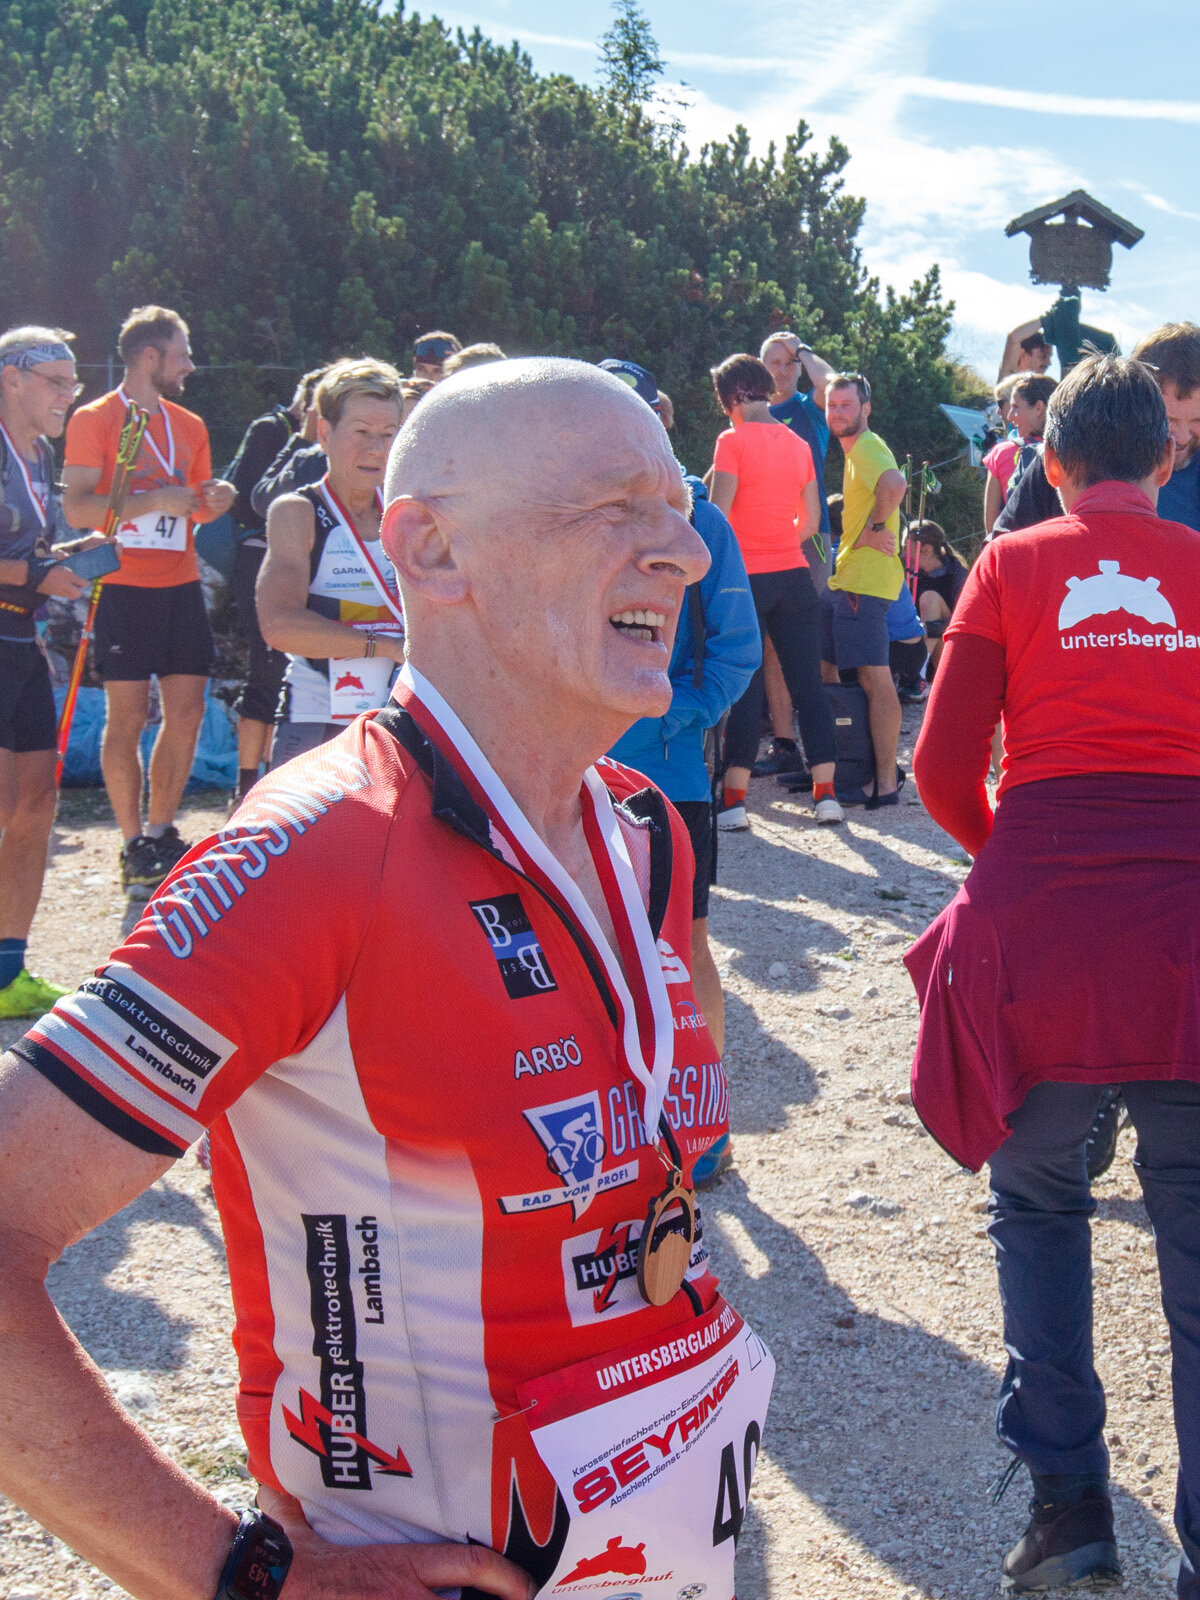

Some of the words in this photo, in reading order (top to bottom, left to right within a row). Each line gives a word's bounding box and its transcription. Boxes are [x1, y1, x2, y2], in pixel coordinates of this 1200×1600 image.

[155, 515, 177, 538] 47
[332, 567, 367, 575] GARMI
[125, 1035, 197, 1094] Lambach
[514, 1034, 583, 1079] ARBÖ
[522, 1194, 552, 1207] RAD
[563, 1183, 590, 1198] VOM
[597, 1169, 628, 1188] PROFI
[355, 1215, 385, 1324] Lambach
[580, 1249, 640, 1282] HUBE
[315, 1220, 350, 1366] Eektrotechnik
[596, 1319, 720, 1391] UNTERSBERGLAUF
[326, 1371, 360, 1483] HUBER
[572, 1359, 739, 1514] SEYRINGER
[552, 1570, 674, 1594] untersberglauf.
